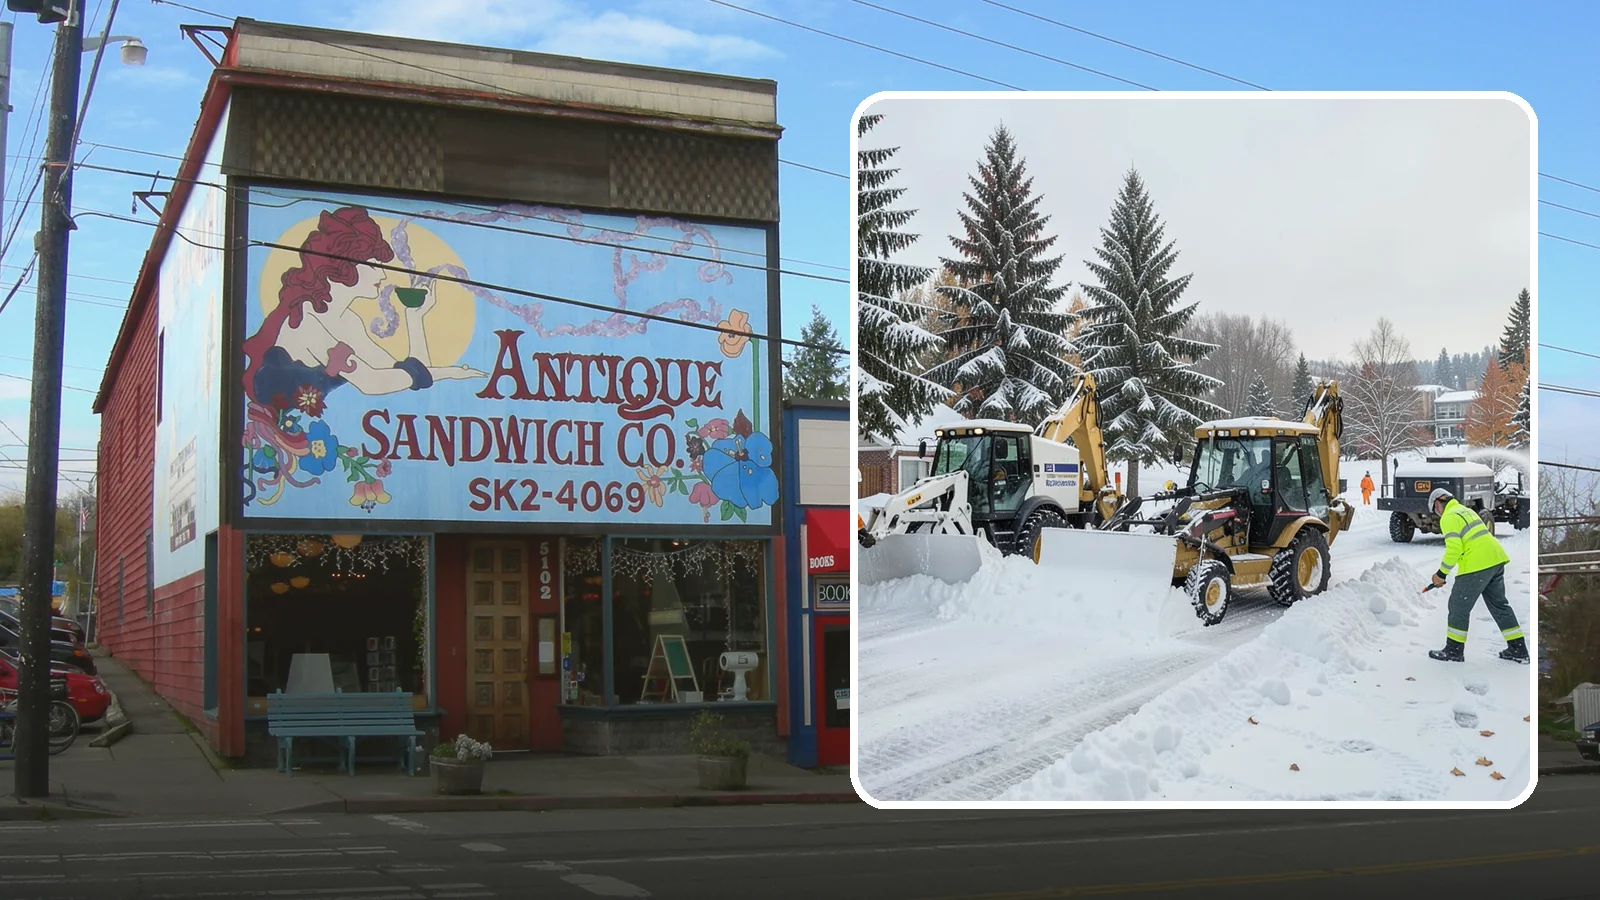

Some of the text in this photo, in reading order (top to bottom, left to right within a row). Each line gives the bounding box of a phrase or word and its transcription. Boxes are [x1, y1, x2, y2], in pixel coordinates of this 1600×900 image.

[477, 329, 724, 420] ANTIQUE
[361, 408, 685, 469] SANDWICH CO.
[468, 477, 646, 514] SK2-4069
[538, 541, 552, 600] 5102
[809, 555, 836, 570] BOOKS
